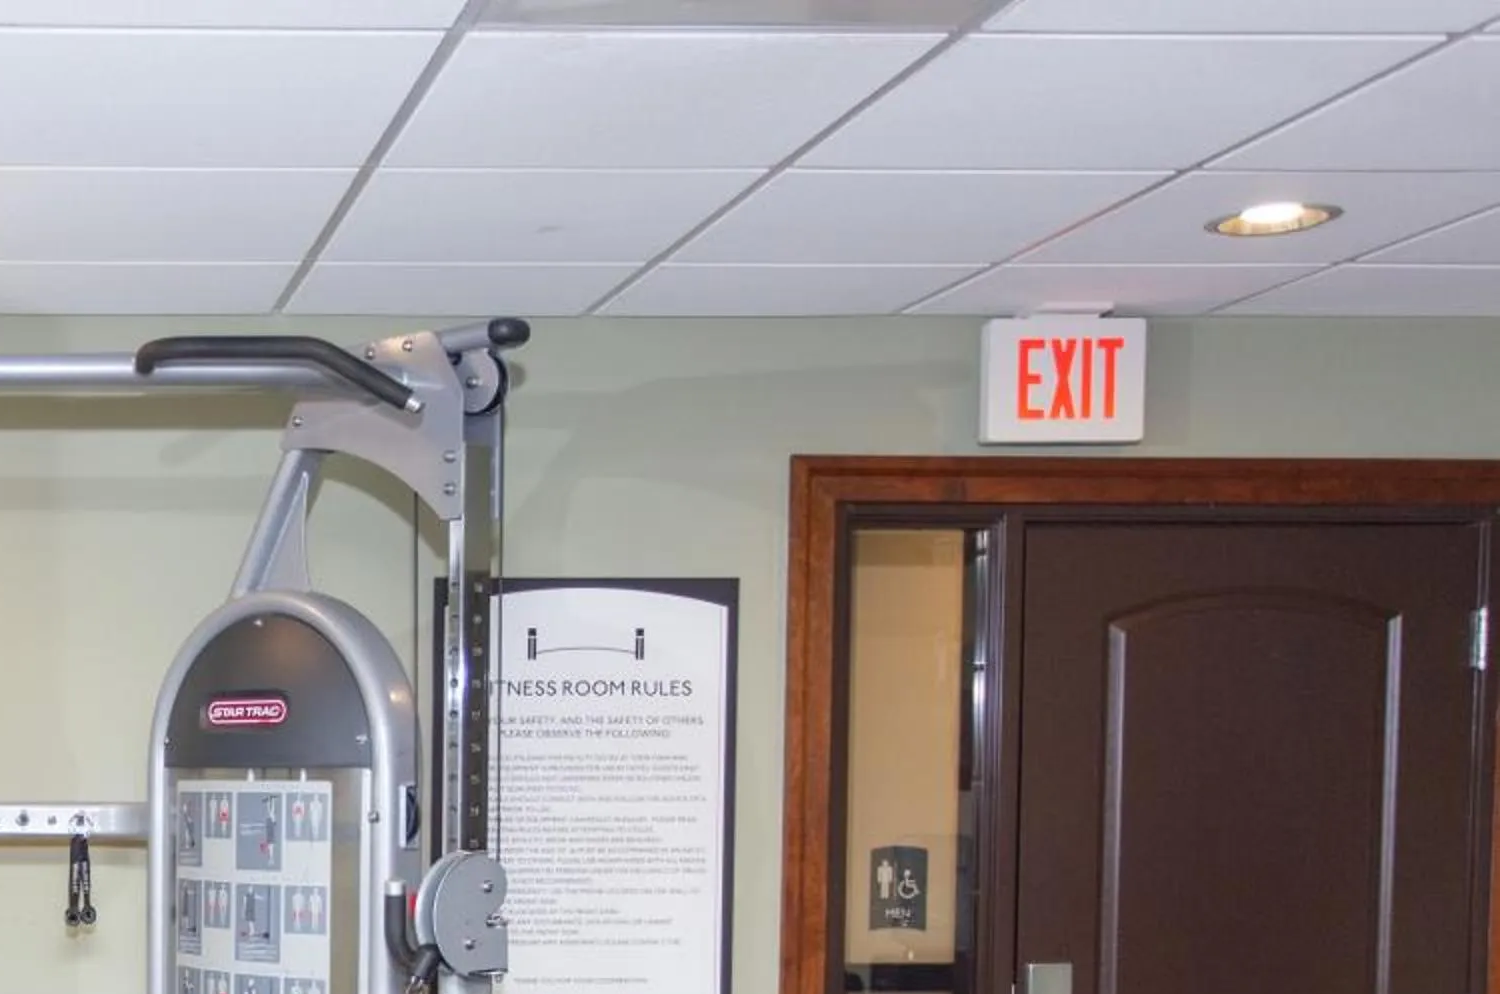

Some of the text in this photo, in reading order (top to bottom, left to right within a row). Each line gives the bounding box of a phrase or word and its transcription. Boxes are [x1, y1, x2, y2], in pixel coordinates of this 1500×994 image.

[1017, 337, 1125, 420] EXIT
[562, 679, 625, 697] ROOM
[631, 679, 692, 697] RULES
[212, 705, 281, 718] STAR TRAC
